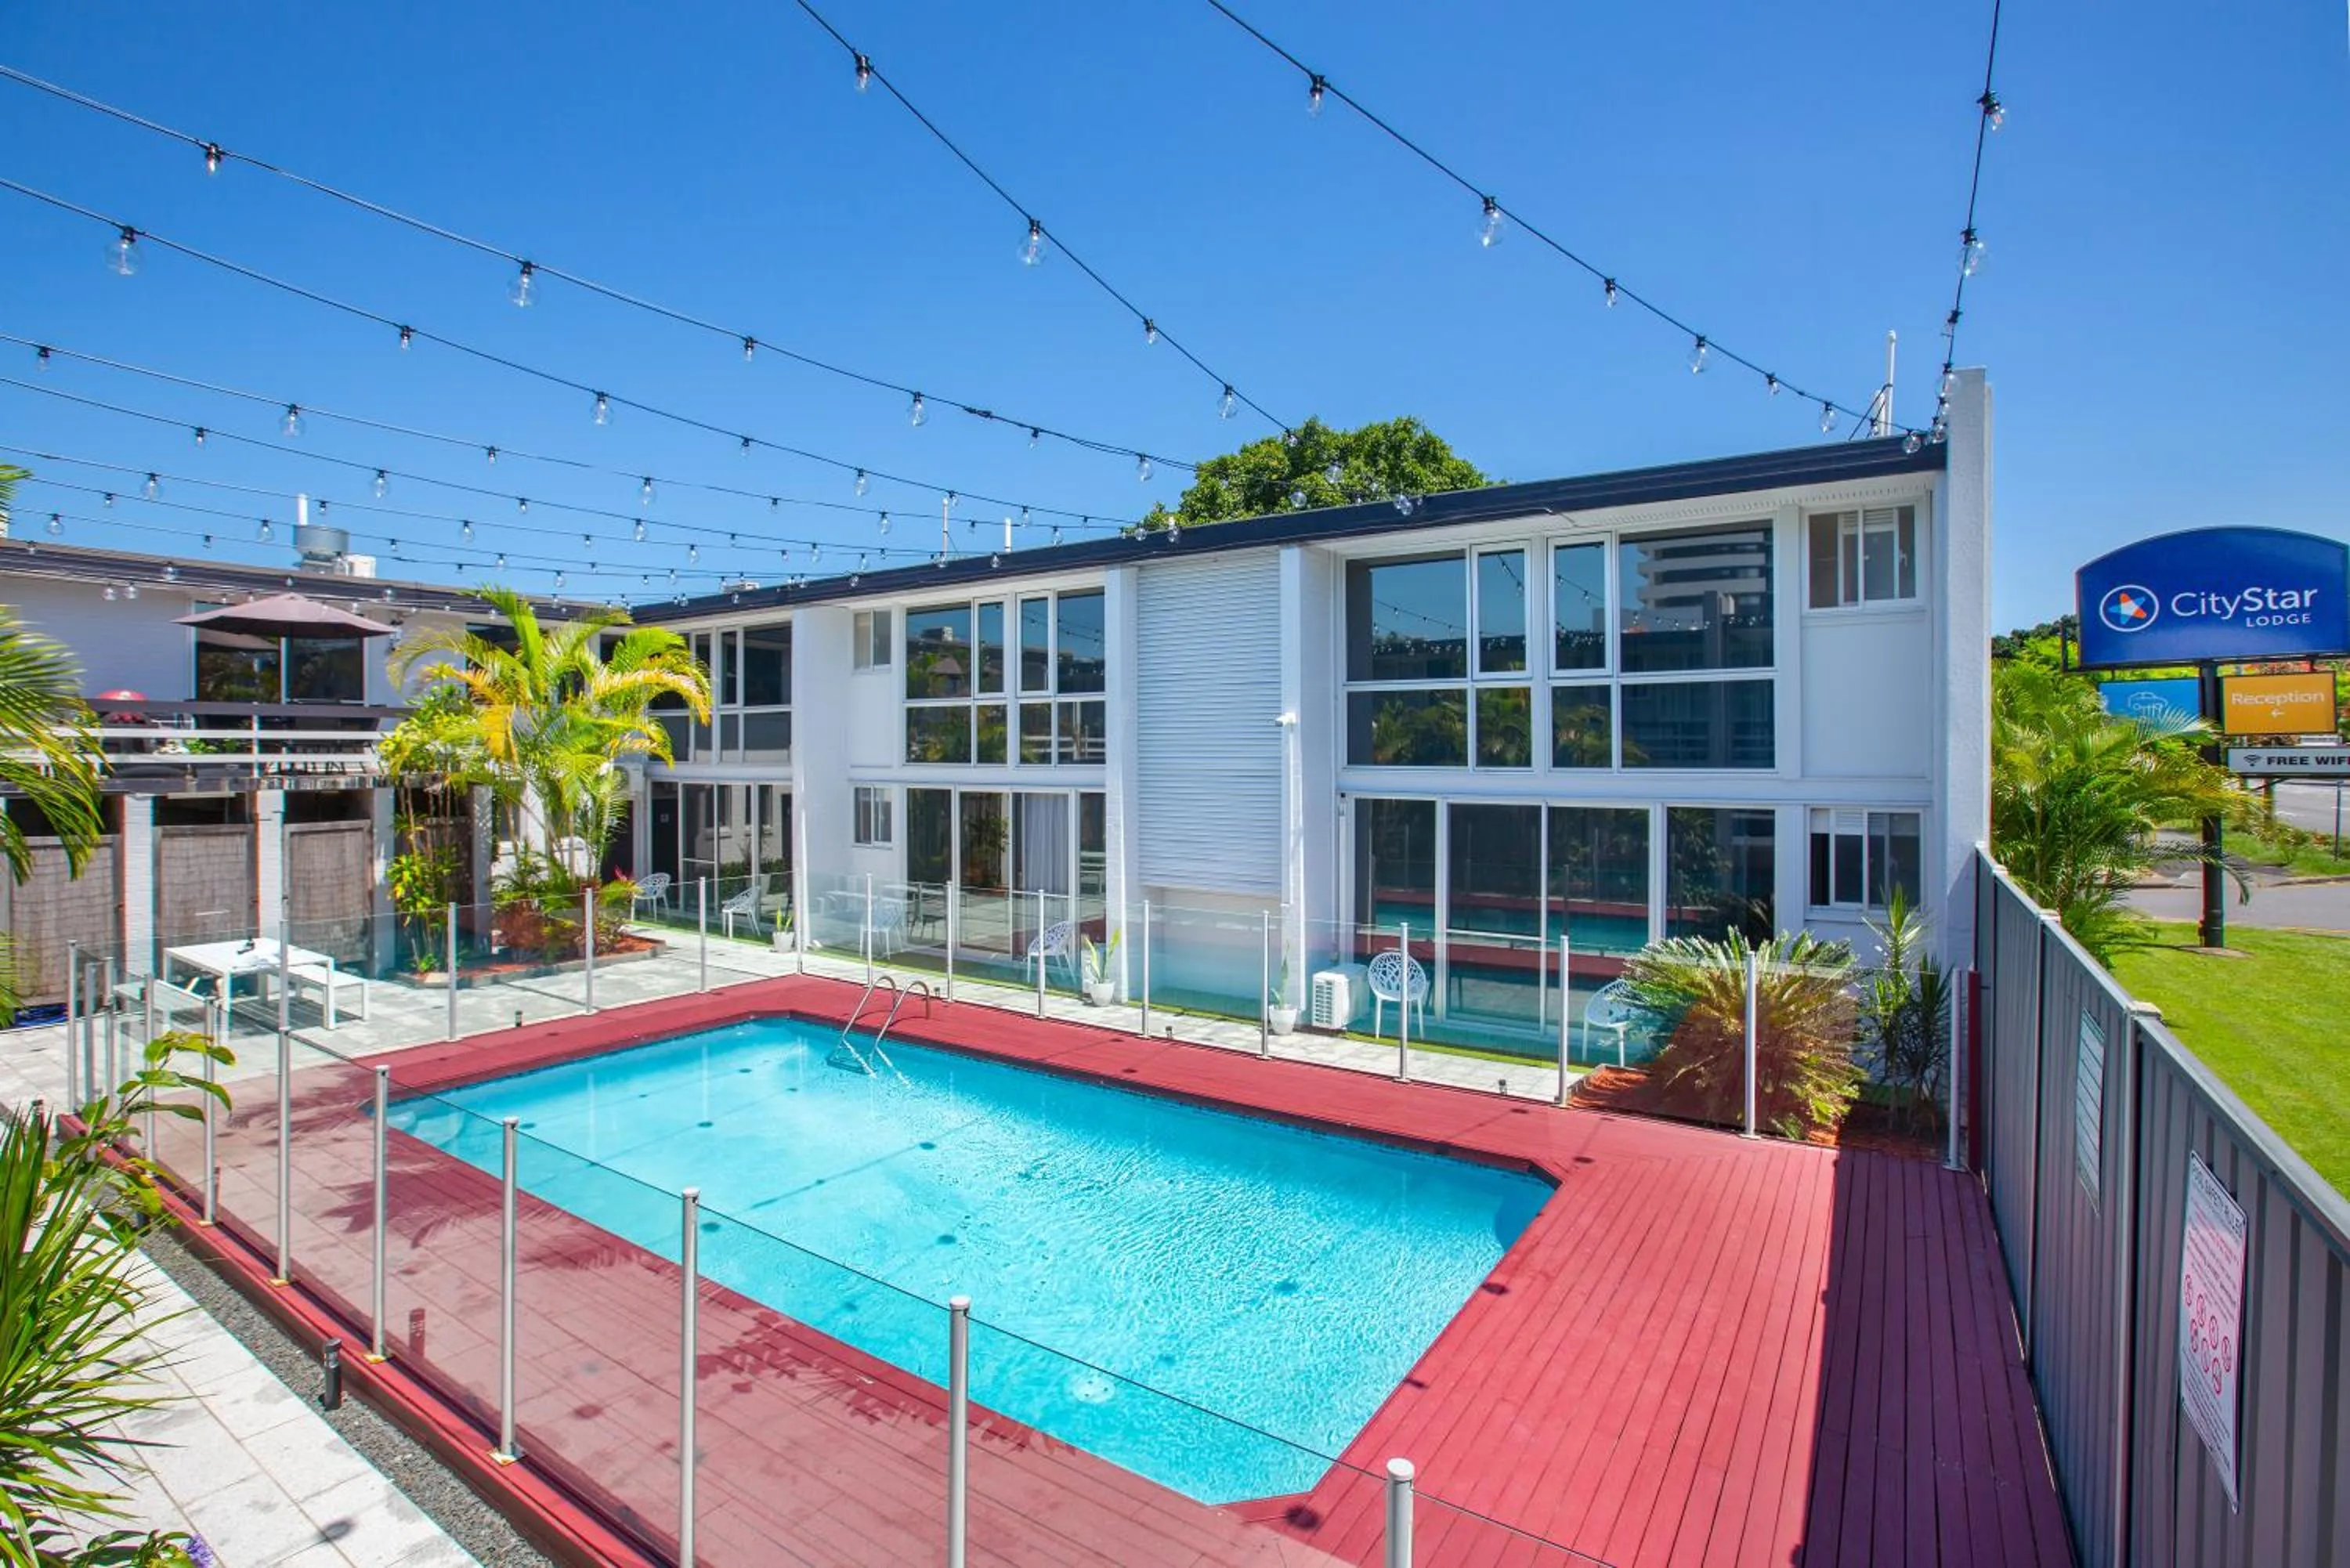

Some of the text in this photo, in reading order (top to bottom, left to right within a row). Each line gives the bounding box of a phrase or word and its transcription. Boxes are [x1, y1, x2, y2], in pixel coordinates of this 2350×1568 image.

[2171, 587, 2319, 620] CityStar
[2245, 612, 2312, 628] LODGE
[2231, 690, 2325, 706] Reception
[2266, 756, 2309, 765] FREE
